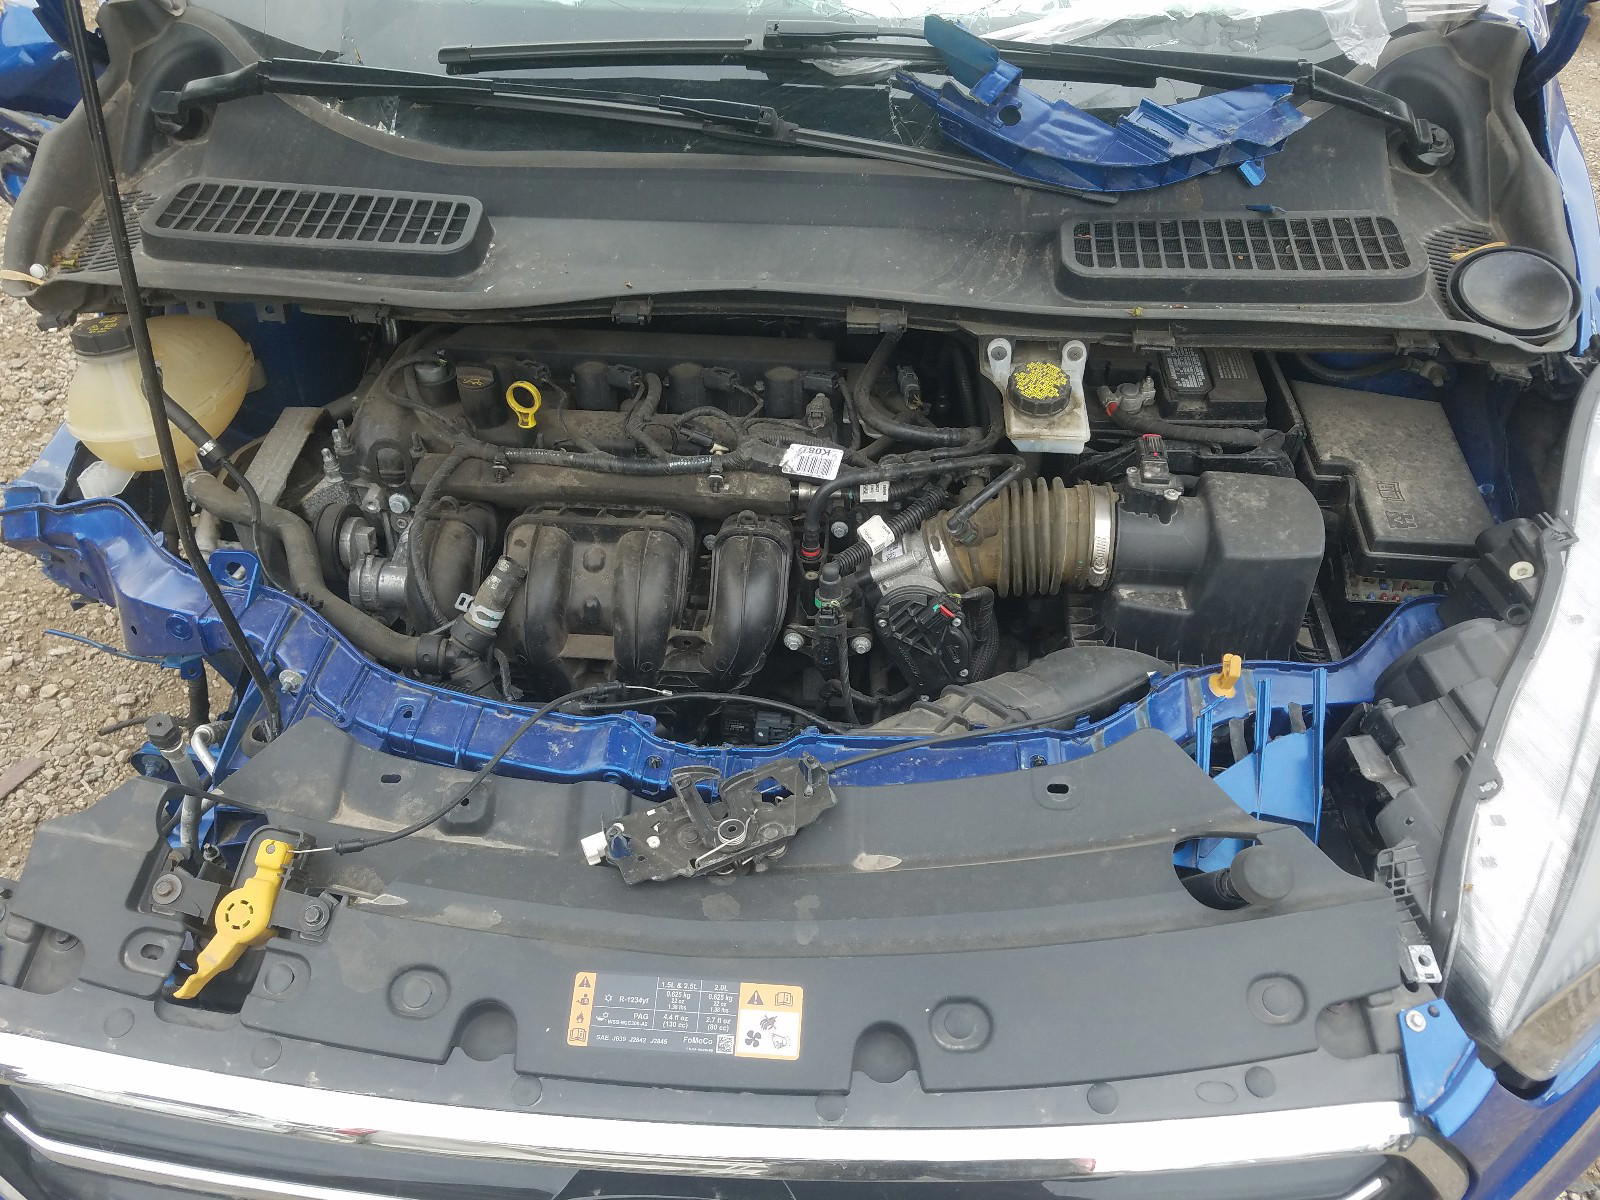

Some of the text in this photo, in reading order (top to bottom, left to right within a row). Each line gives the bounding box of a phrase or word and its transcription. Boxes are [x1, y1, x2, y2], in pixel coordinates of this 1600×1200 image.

[661, 981, 675, 989] 1.5L
[714, 984, 728, 992] 2.0L
[666, 990, 682, 998] 0.625
[708, 993, 733, 1003] 0.625 kg
[619, 996, 650, 1004] R-1234yf
[596, 1033, 609, 1041] SAE
[683, 1035, 713, 1045] FoMoCo
